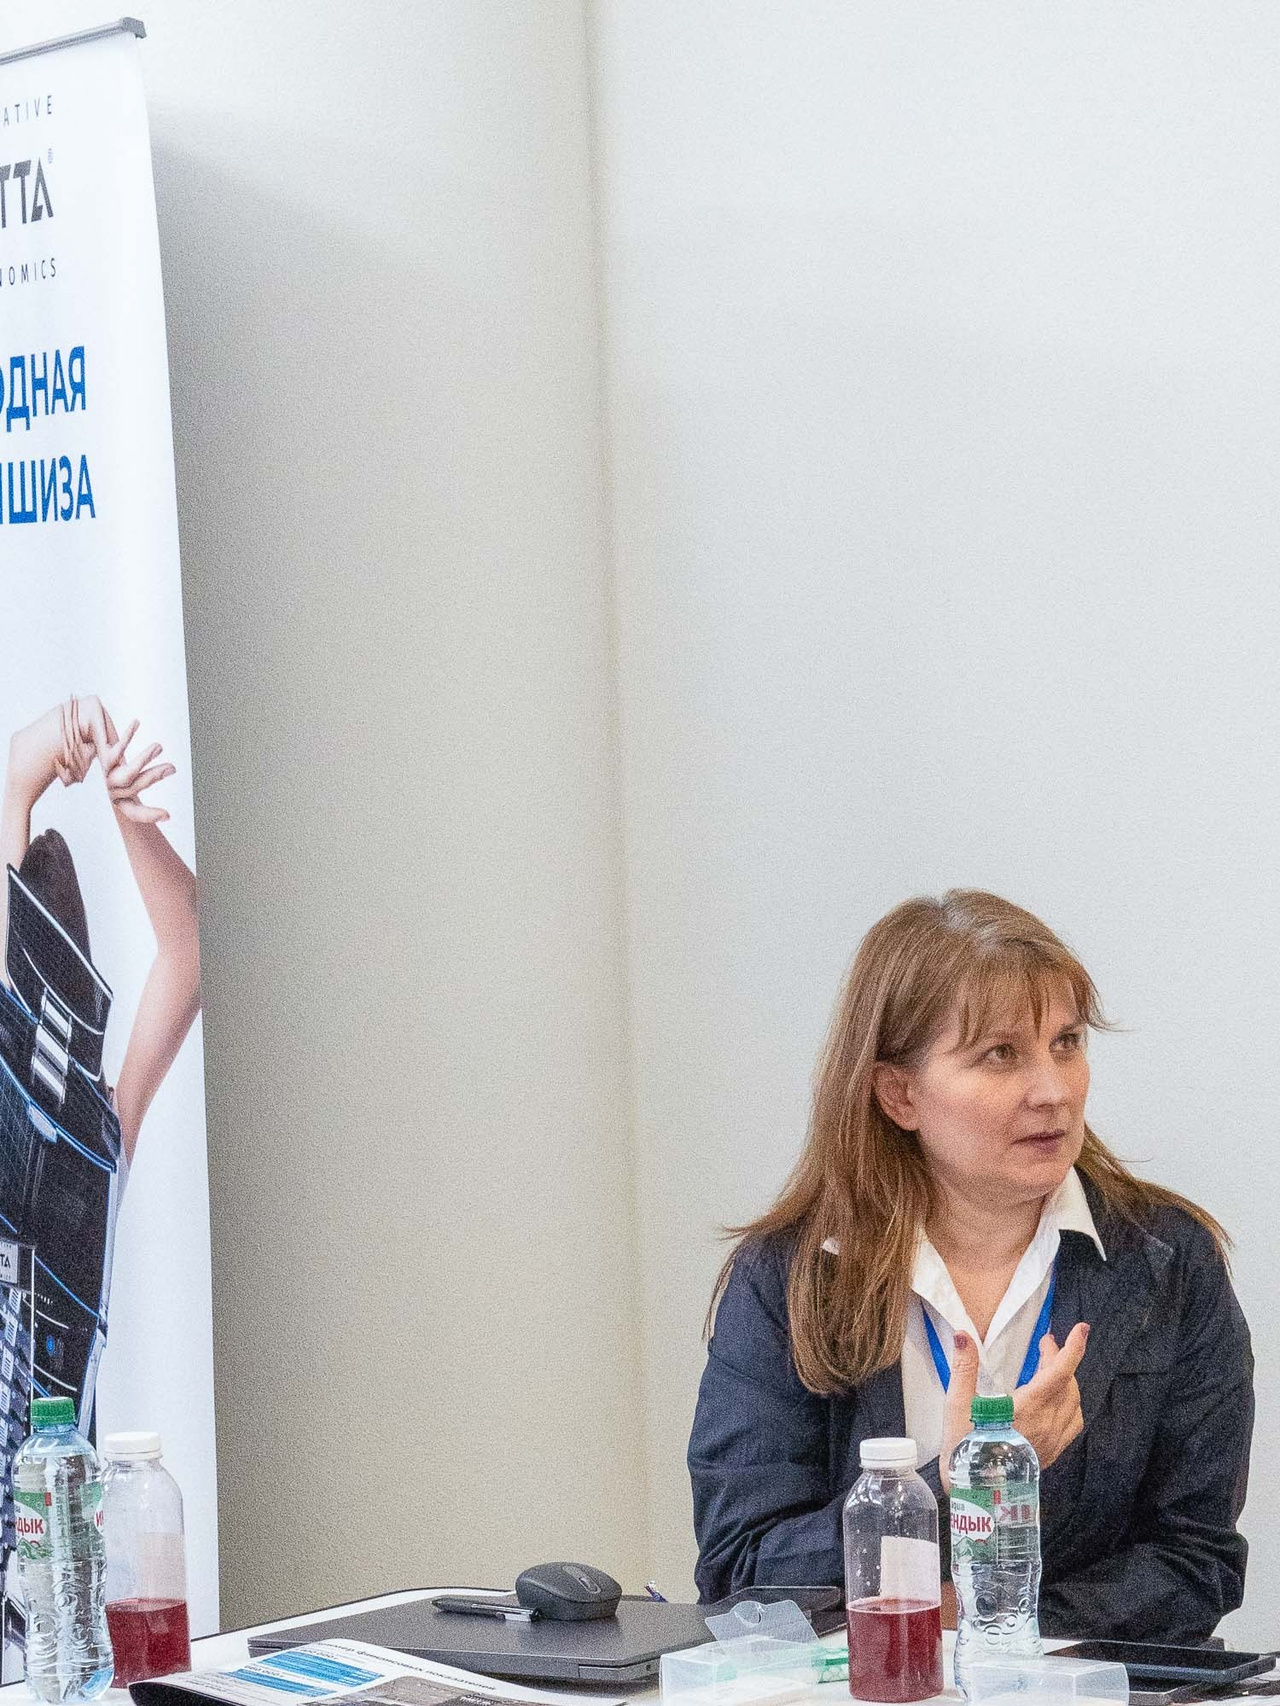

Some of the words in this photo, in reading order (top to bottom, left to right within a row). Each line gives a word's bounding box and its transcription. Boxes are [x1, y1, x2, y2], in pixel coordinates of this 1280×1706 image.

[0, 257, 57, 287] OMICS
[0, 346, 86, 433] ДНАЯ
[0, 454, 96, 525] ШИЗА
